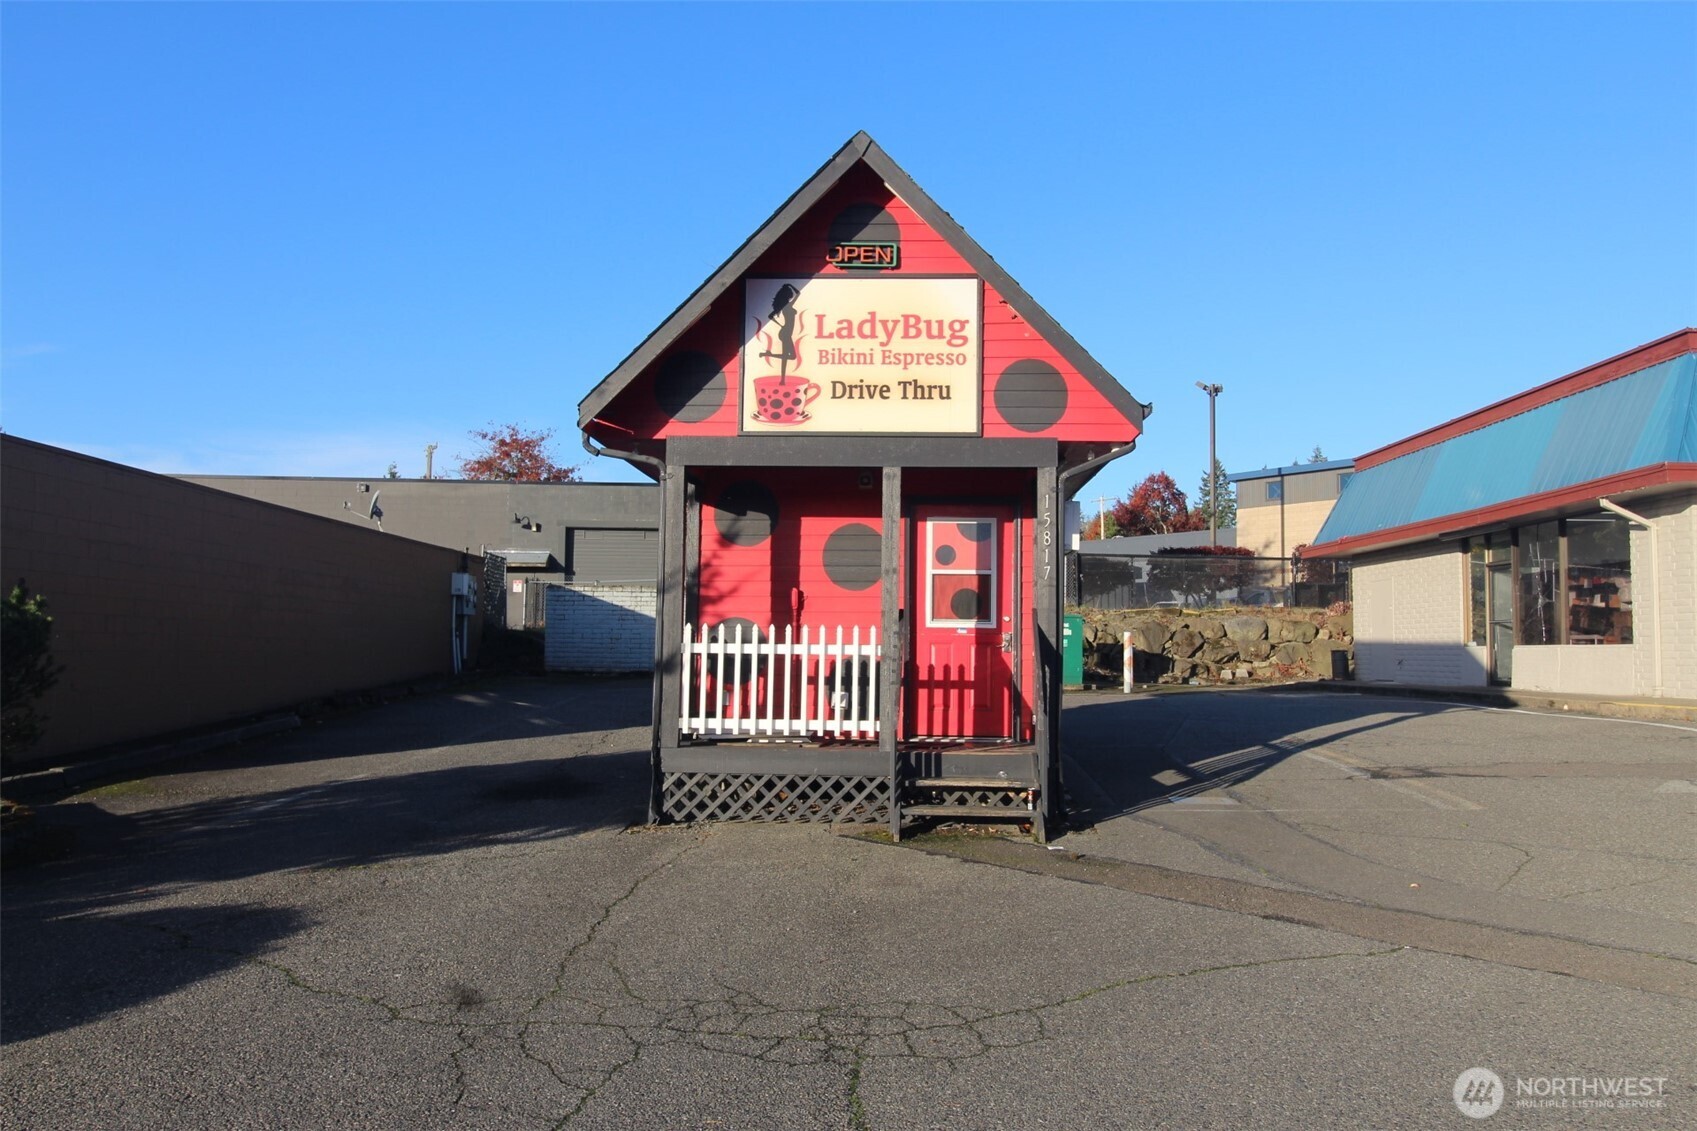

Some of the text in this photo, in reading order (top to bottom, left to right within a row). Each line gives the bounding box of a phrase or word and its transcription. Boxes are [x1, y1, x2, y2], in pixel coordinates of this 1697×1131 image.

[826, 246, 892, 263] OPEN
[814, 311, 970, 347] LadyBug
[817, 348, 967, 370] Bikini Espresso
[830, 379, 952, 400] Drive Thru
[1043, 494, 1051, 580] 15817
